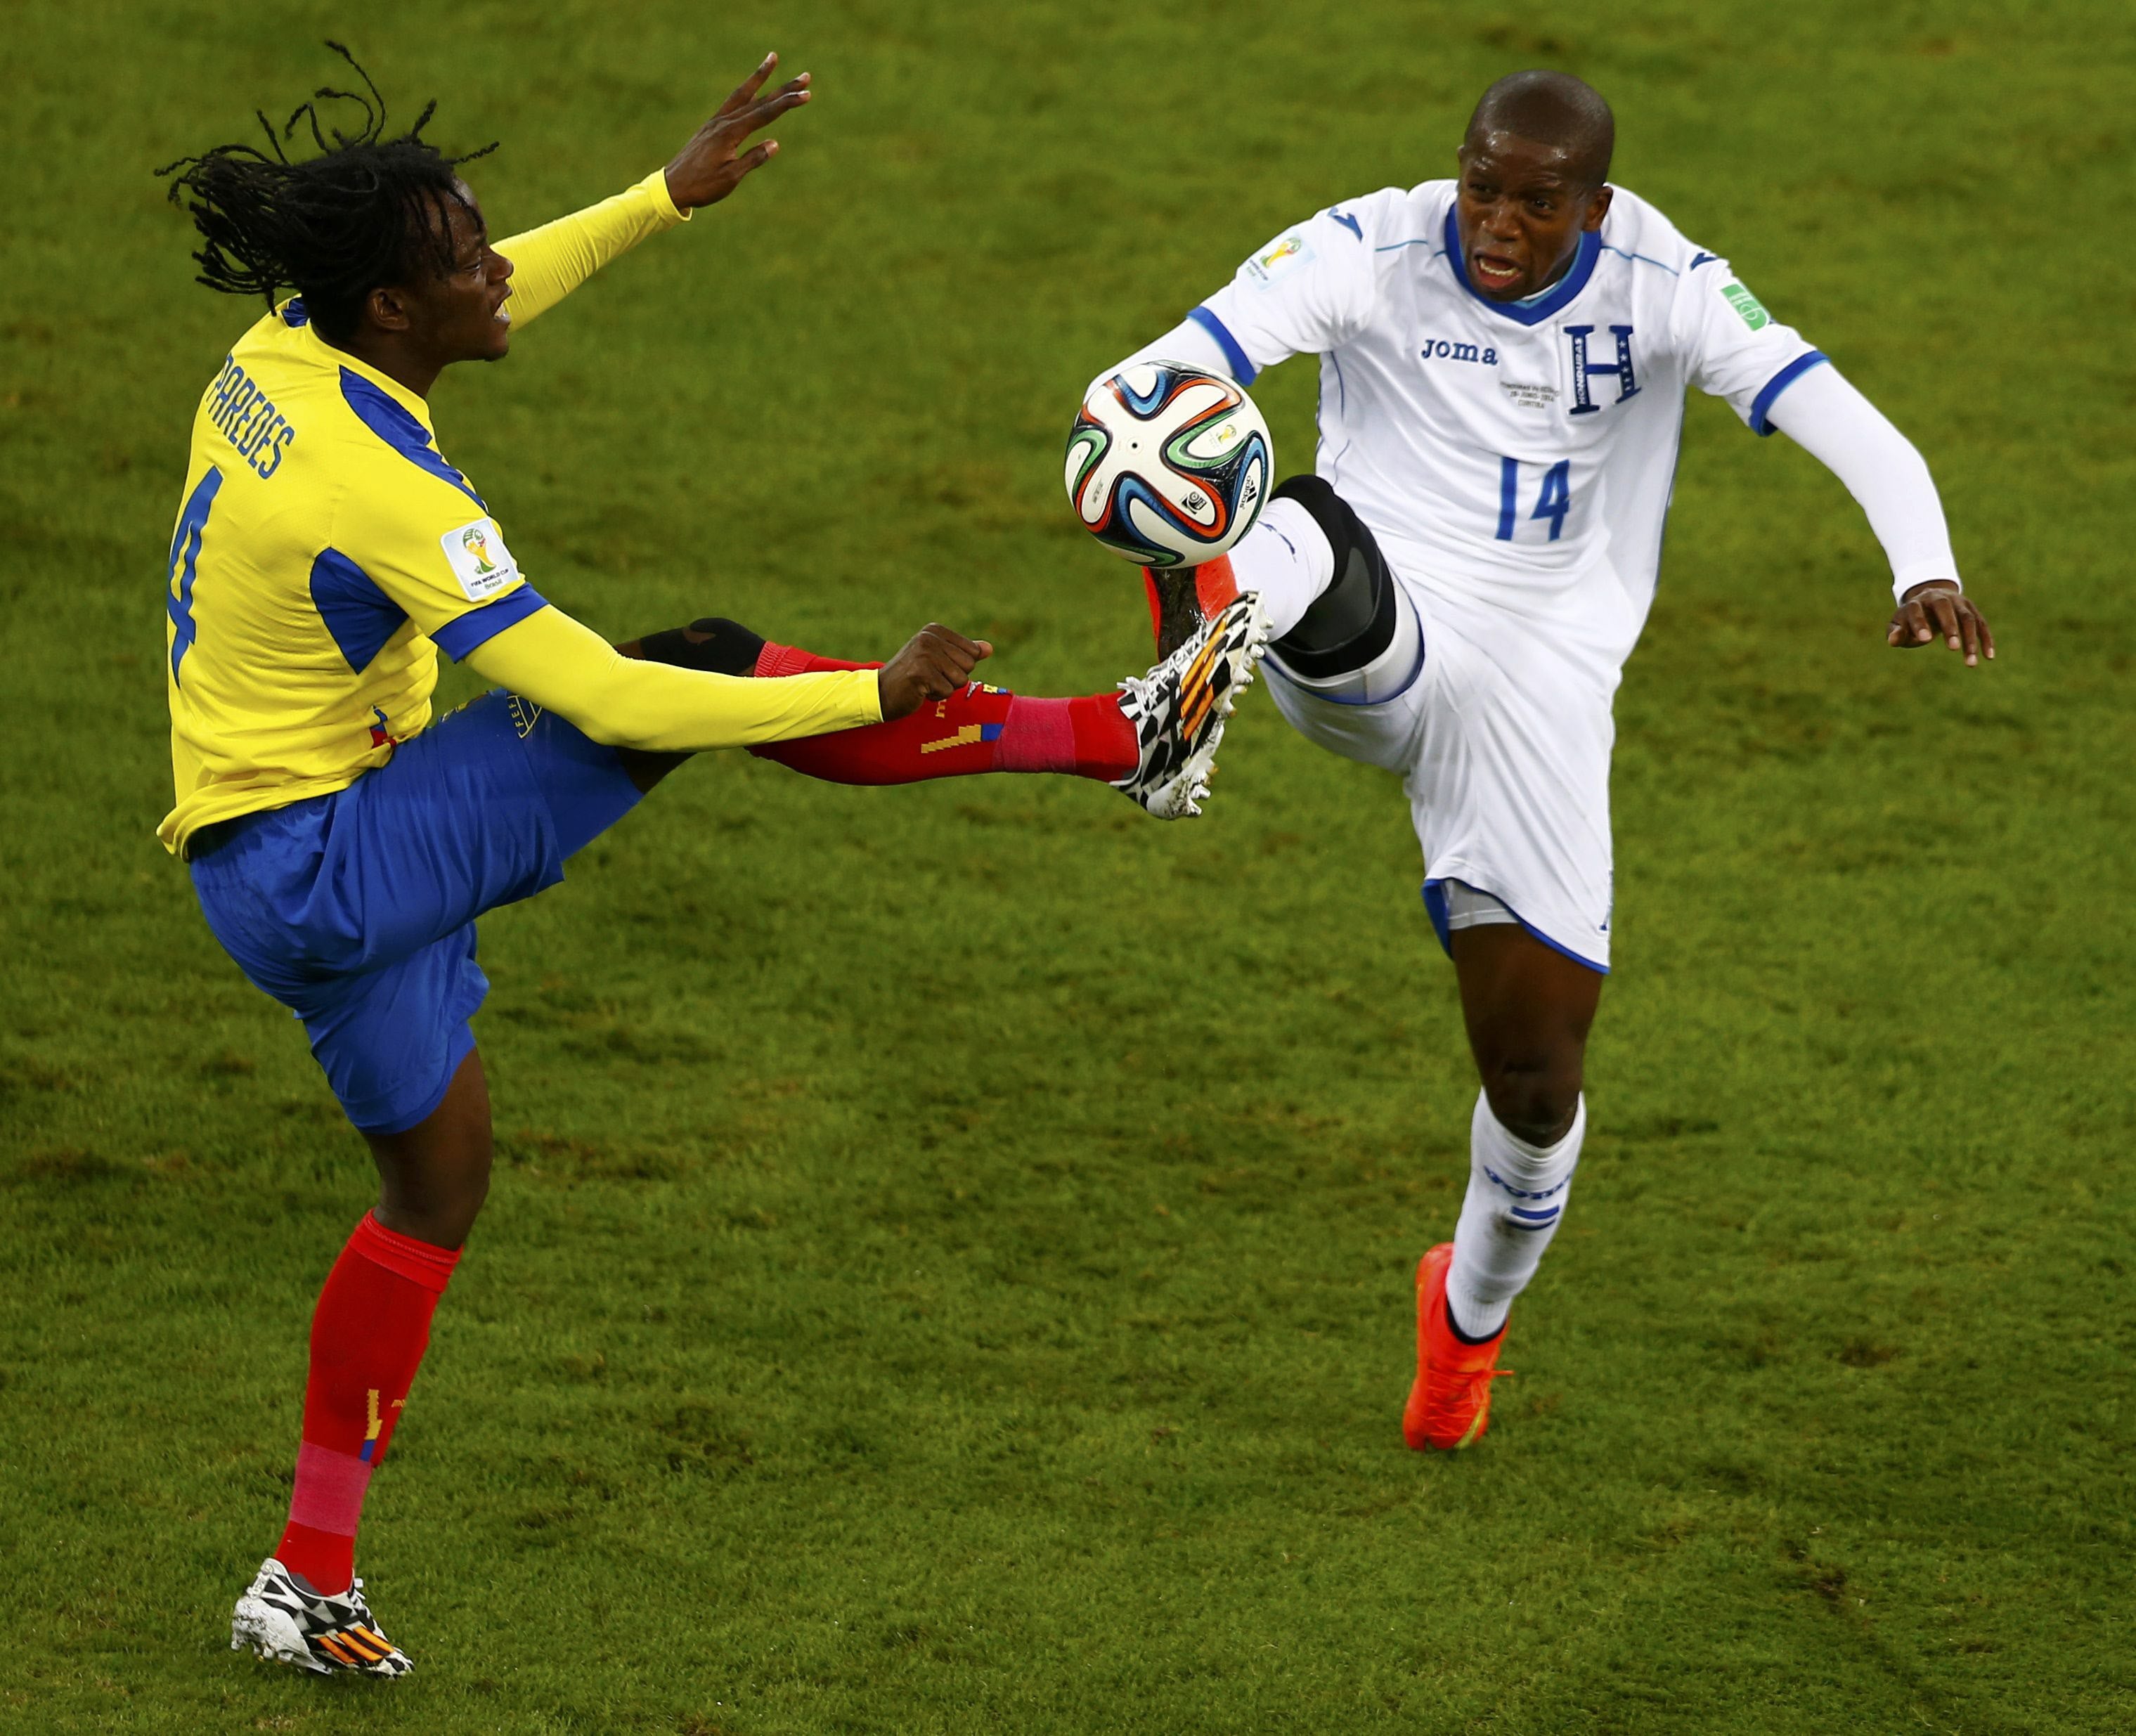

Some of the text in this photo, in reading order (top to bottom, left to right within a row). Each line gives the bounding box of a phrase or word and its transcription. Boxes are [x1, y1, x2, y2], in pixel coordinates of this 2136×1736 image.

[1574, 337, 1587, 405] HONDURAS
[206, 352, 295, 479] PAREDES
[1239, 475, 1251, 508] adidas
[1494, 456, 1570, 541] 14
[482, 572, 500, 583] WORLD
[508, 704, 524, 727] FEF
